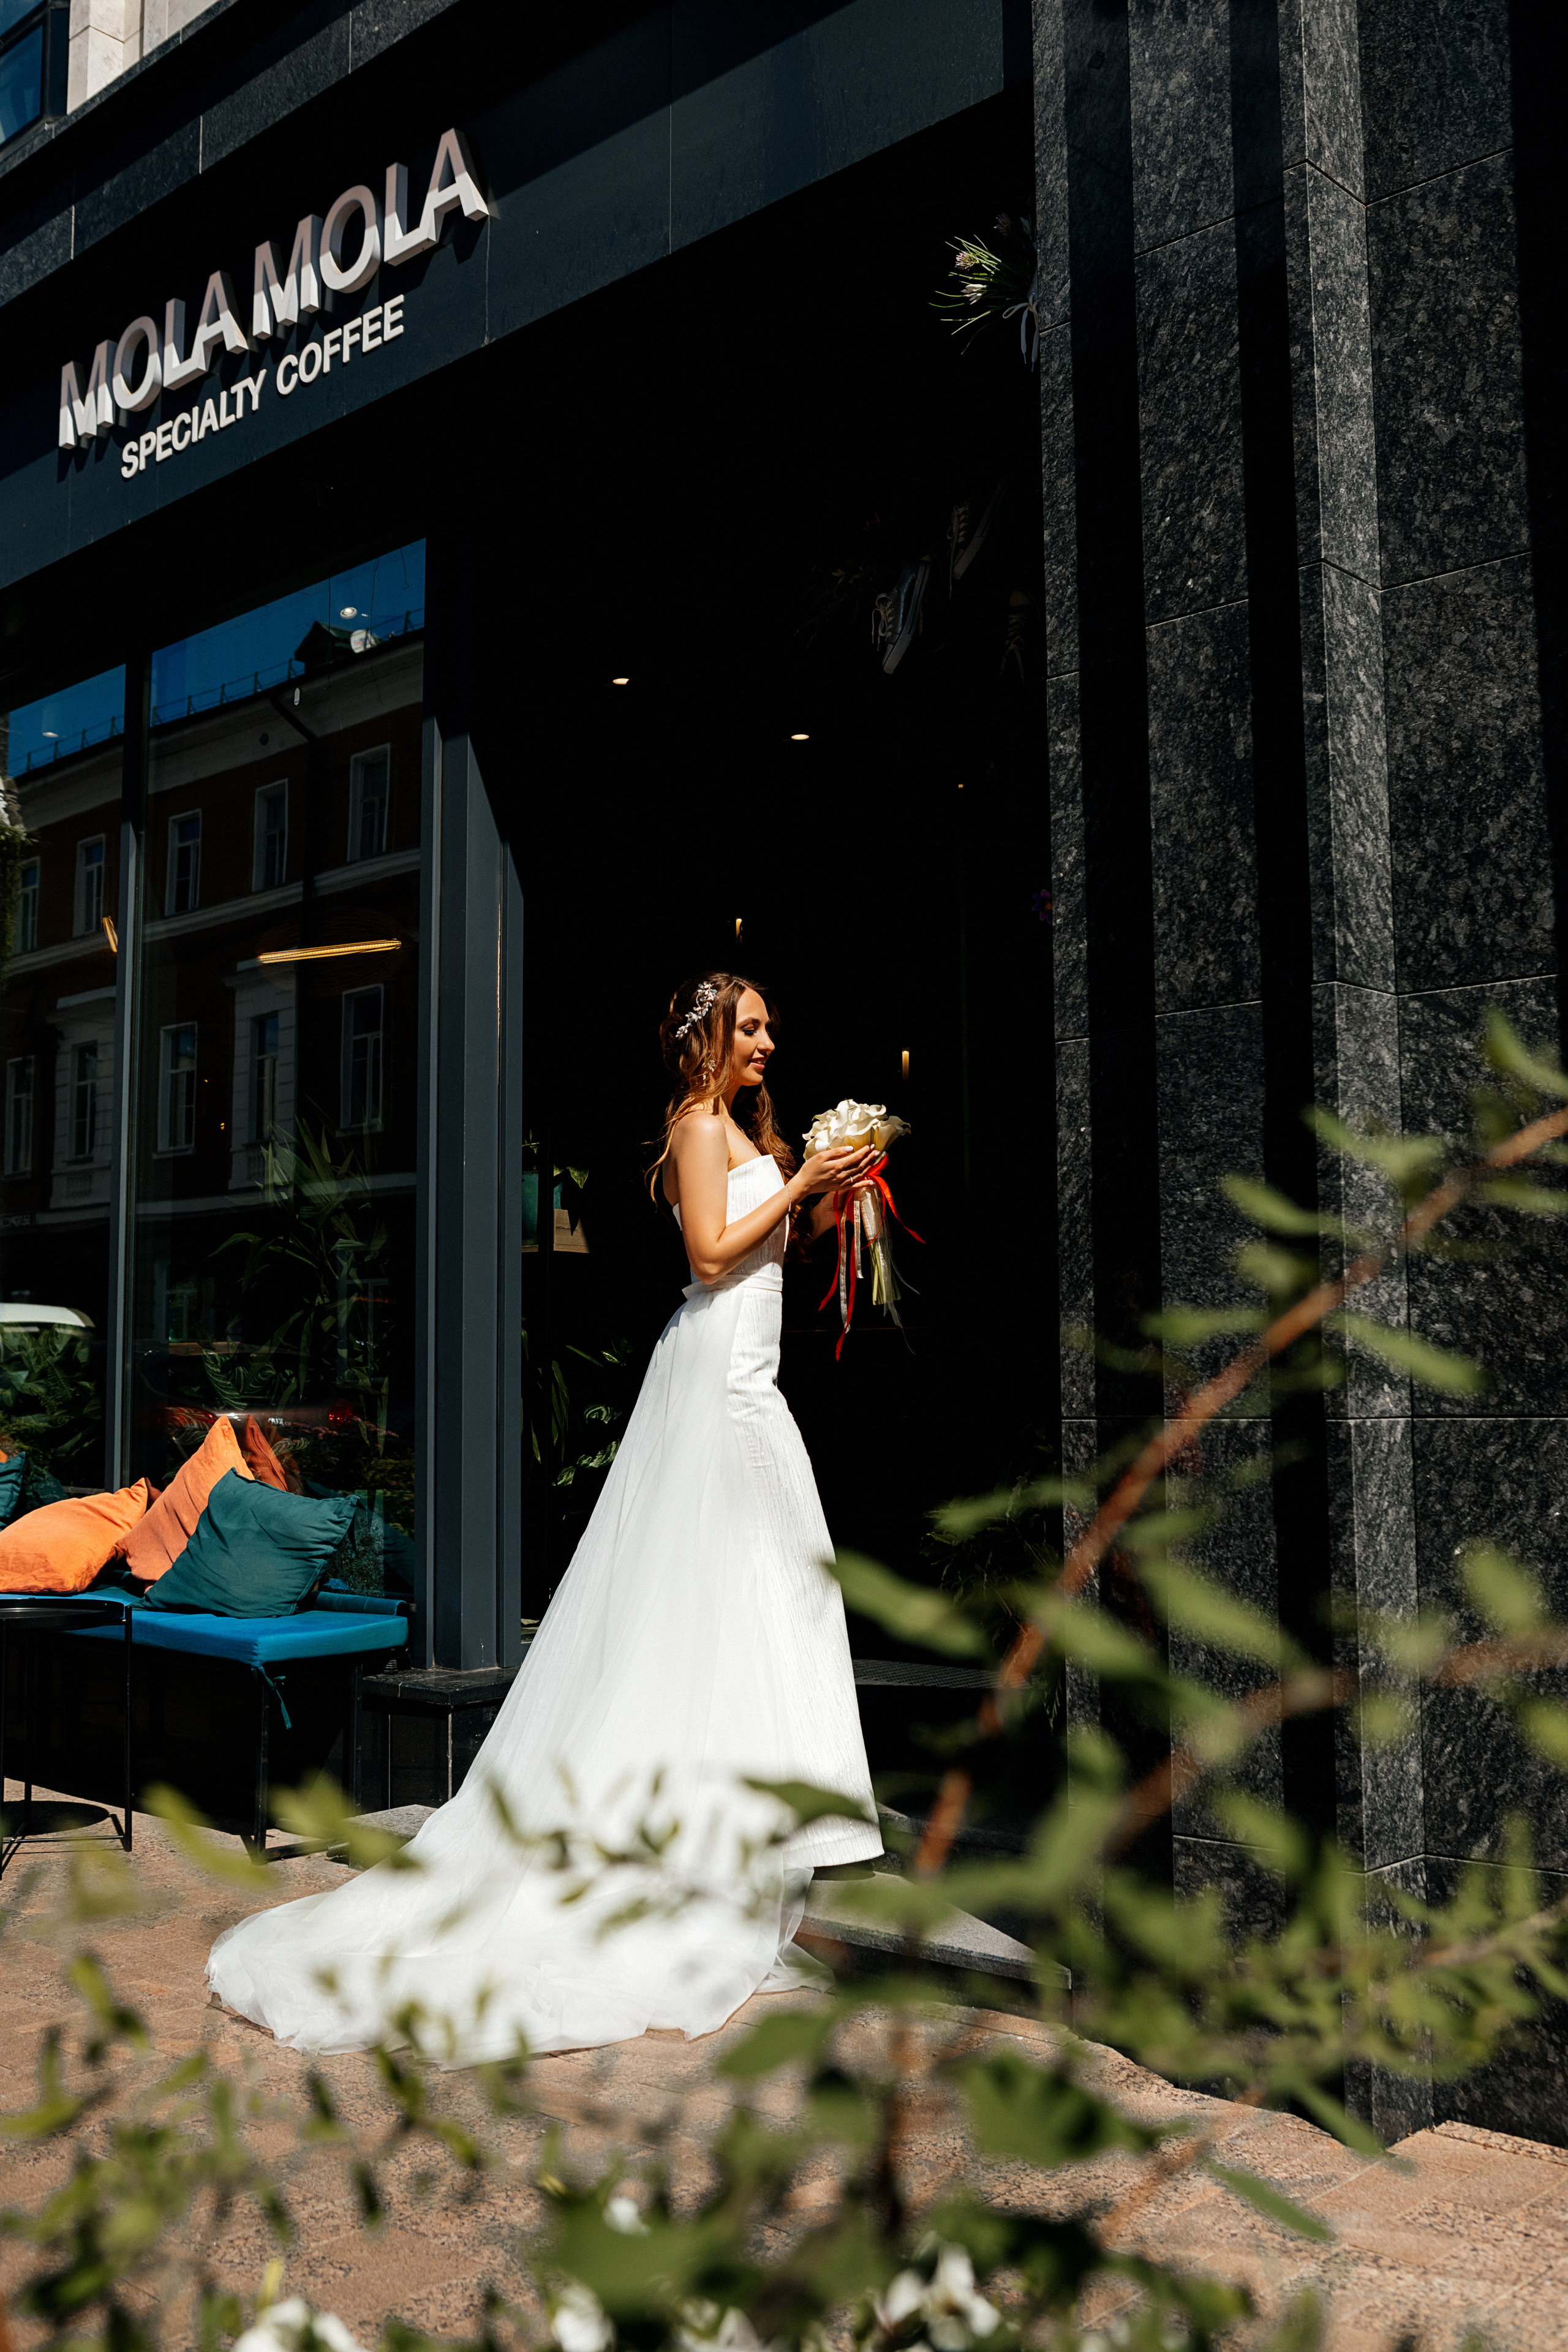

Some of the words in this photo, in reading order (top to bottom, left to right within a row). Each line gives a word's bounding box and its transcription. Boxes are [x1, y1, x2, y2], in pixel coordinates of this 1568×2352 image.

[59, 270, 249, 449] MOLA
[252, 127, 489, 340] MOLA
[121, 368, 267, 479] SPECIALTY
[276, 293, 405, 395] COFFEE
